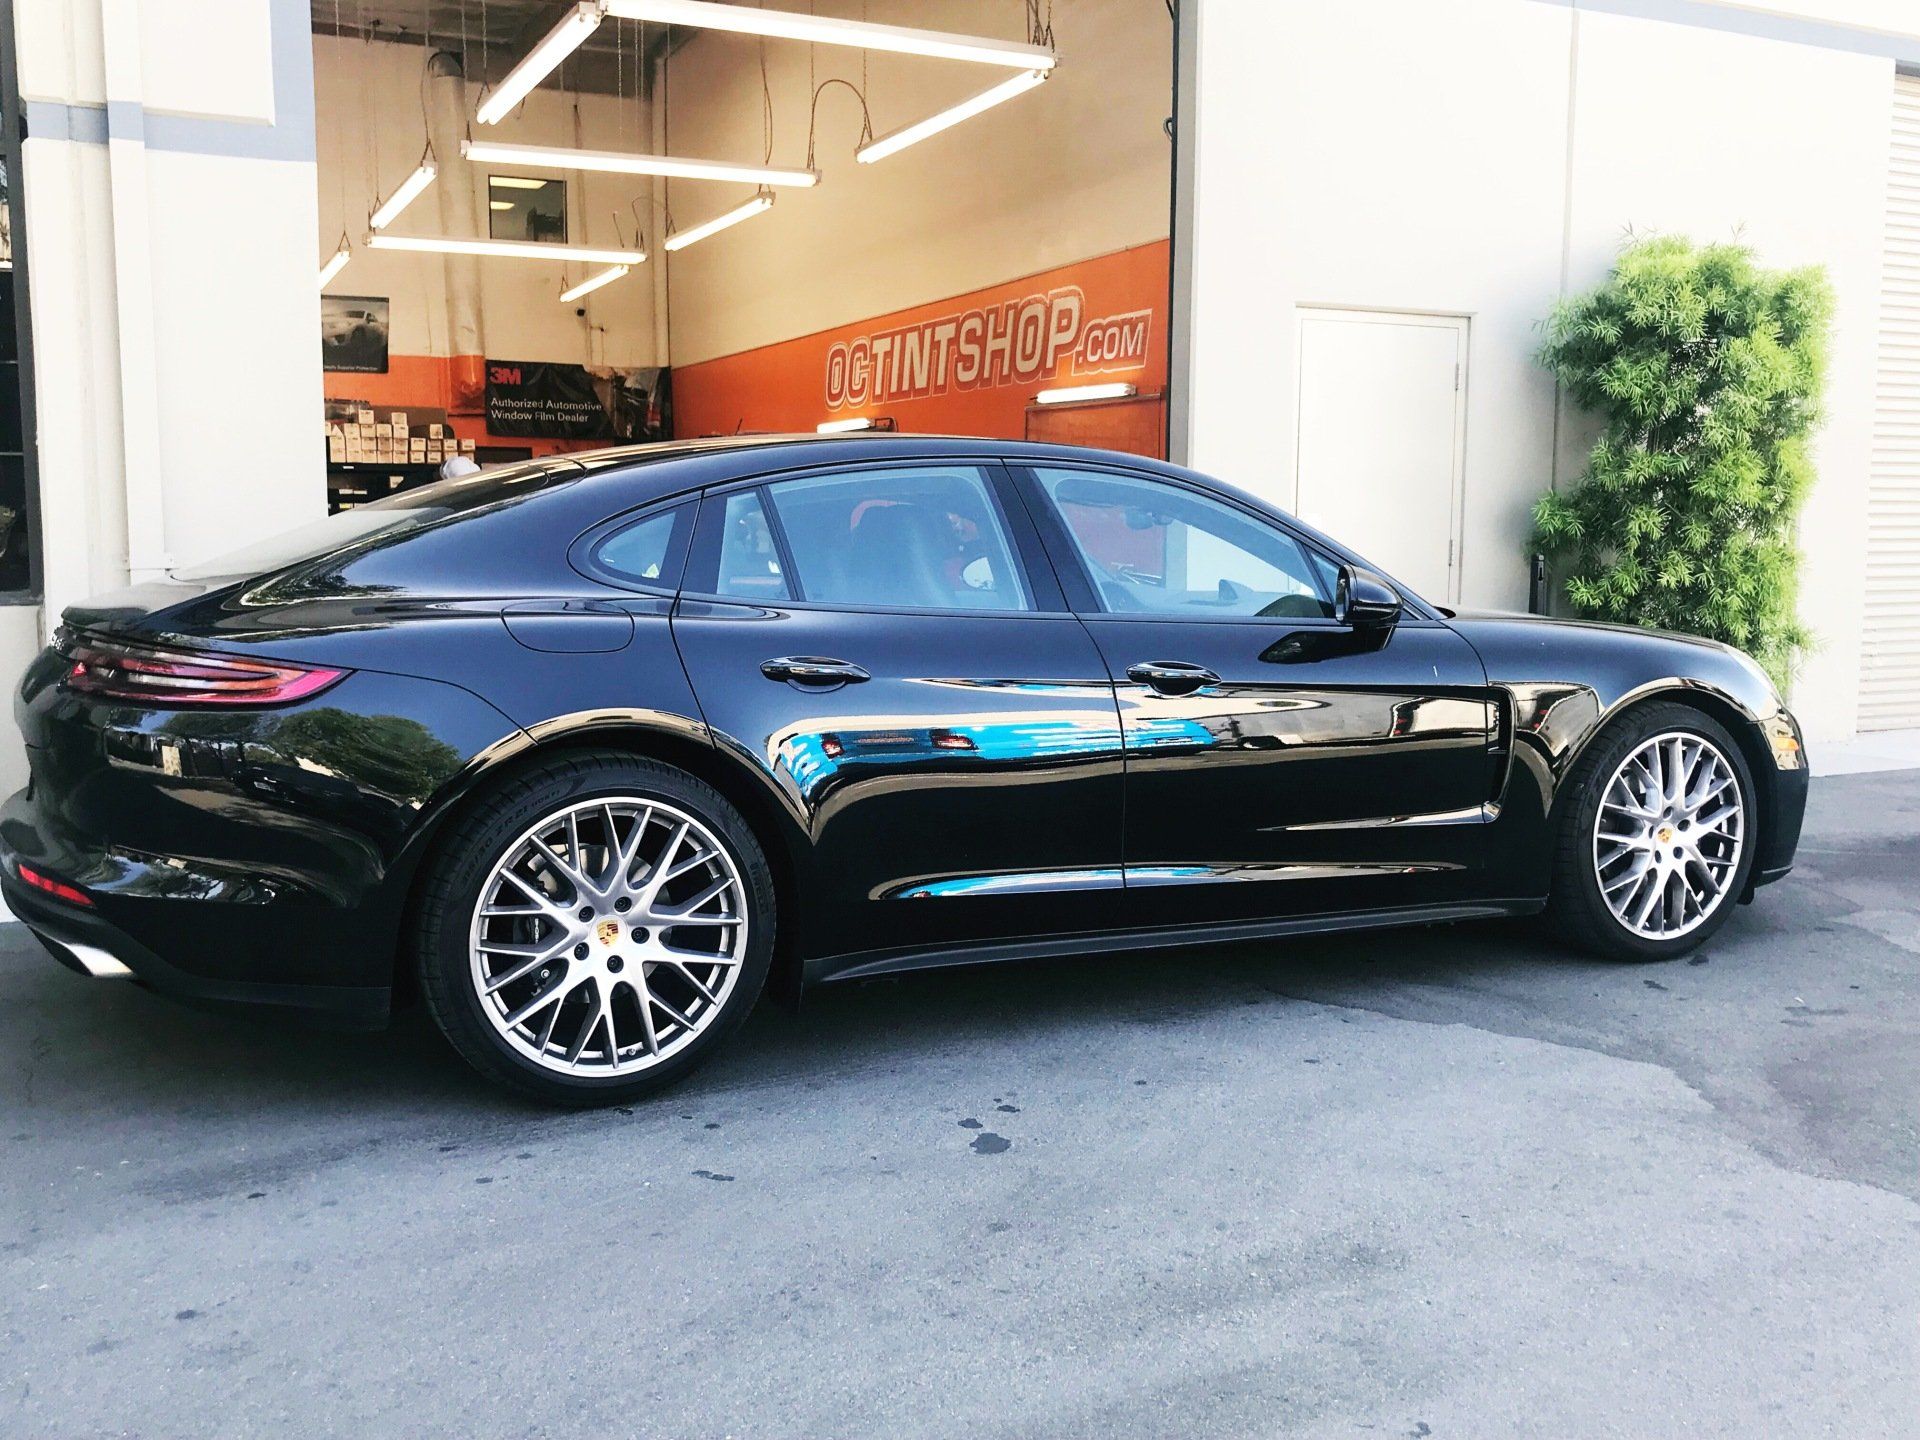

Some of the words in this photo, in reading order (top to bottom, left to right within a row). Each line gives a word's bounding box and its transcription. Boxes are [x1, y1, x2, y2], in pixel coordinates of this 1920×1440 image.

[826, 286, 1151, 410] OCTINTSHOP.COM
[489, 367, 522, 385] 3M
[490, 397, 544, 409] Authorized
[546, 399, 602, 411] Automotive
[491, 410, 533, 421] Window
[534, 411, 555, 421] Film
[558, 412, 589, 422] Dealer
